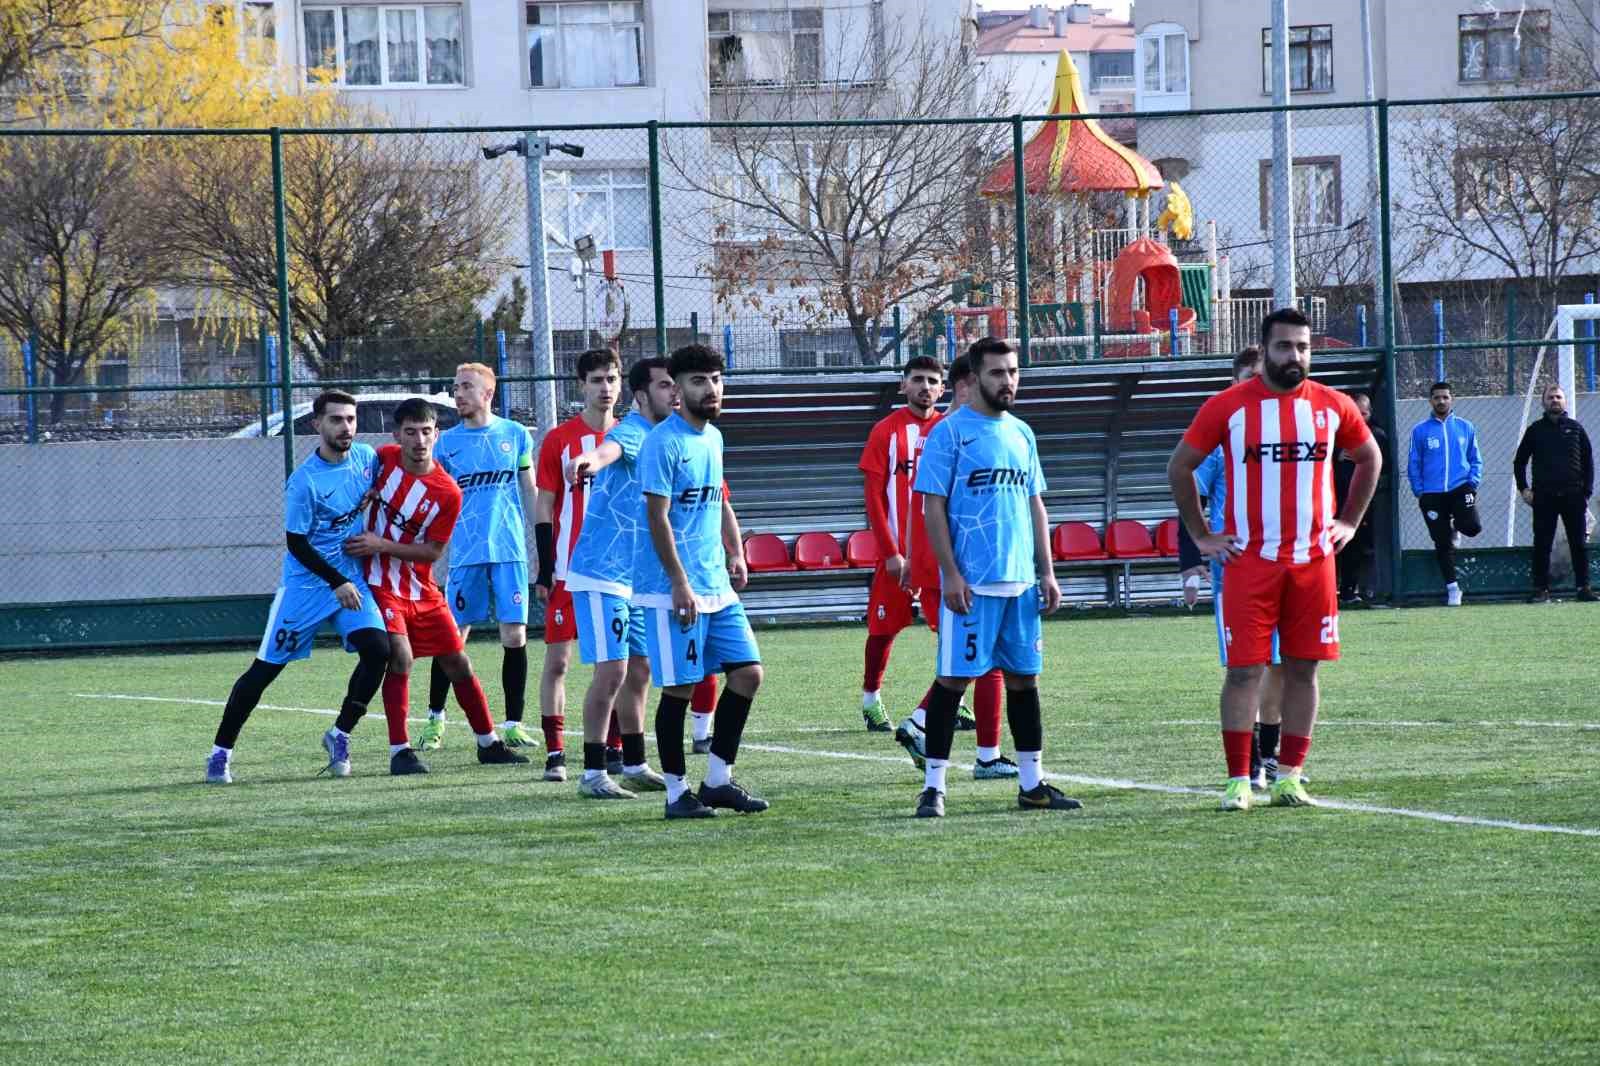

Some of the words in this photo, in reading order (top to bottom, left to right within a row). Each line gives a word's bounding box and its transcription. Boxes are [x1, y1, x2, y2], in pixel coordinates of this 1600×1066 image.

[1242, 441, 1328, 464] AFEEXS
[455, 589, 466, 611] 6
[275, 628, 300, 652] 95
[687, 639, 698, 665] 4
[965, 633, 977, 662] 5
